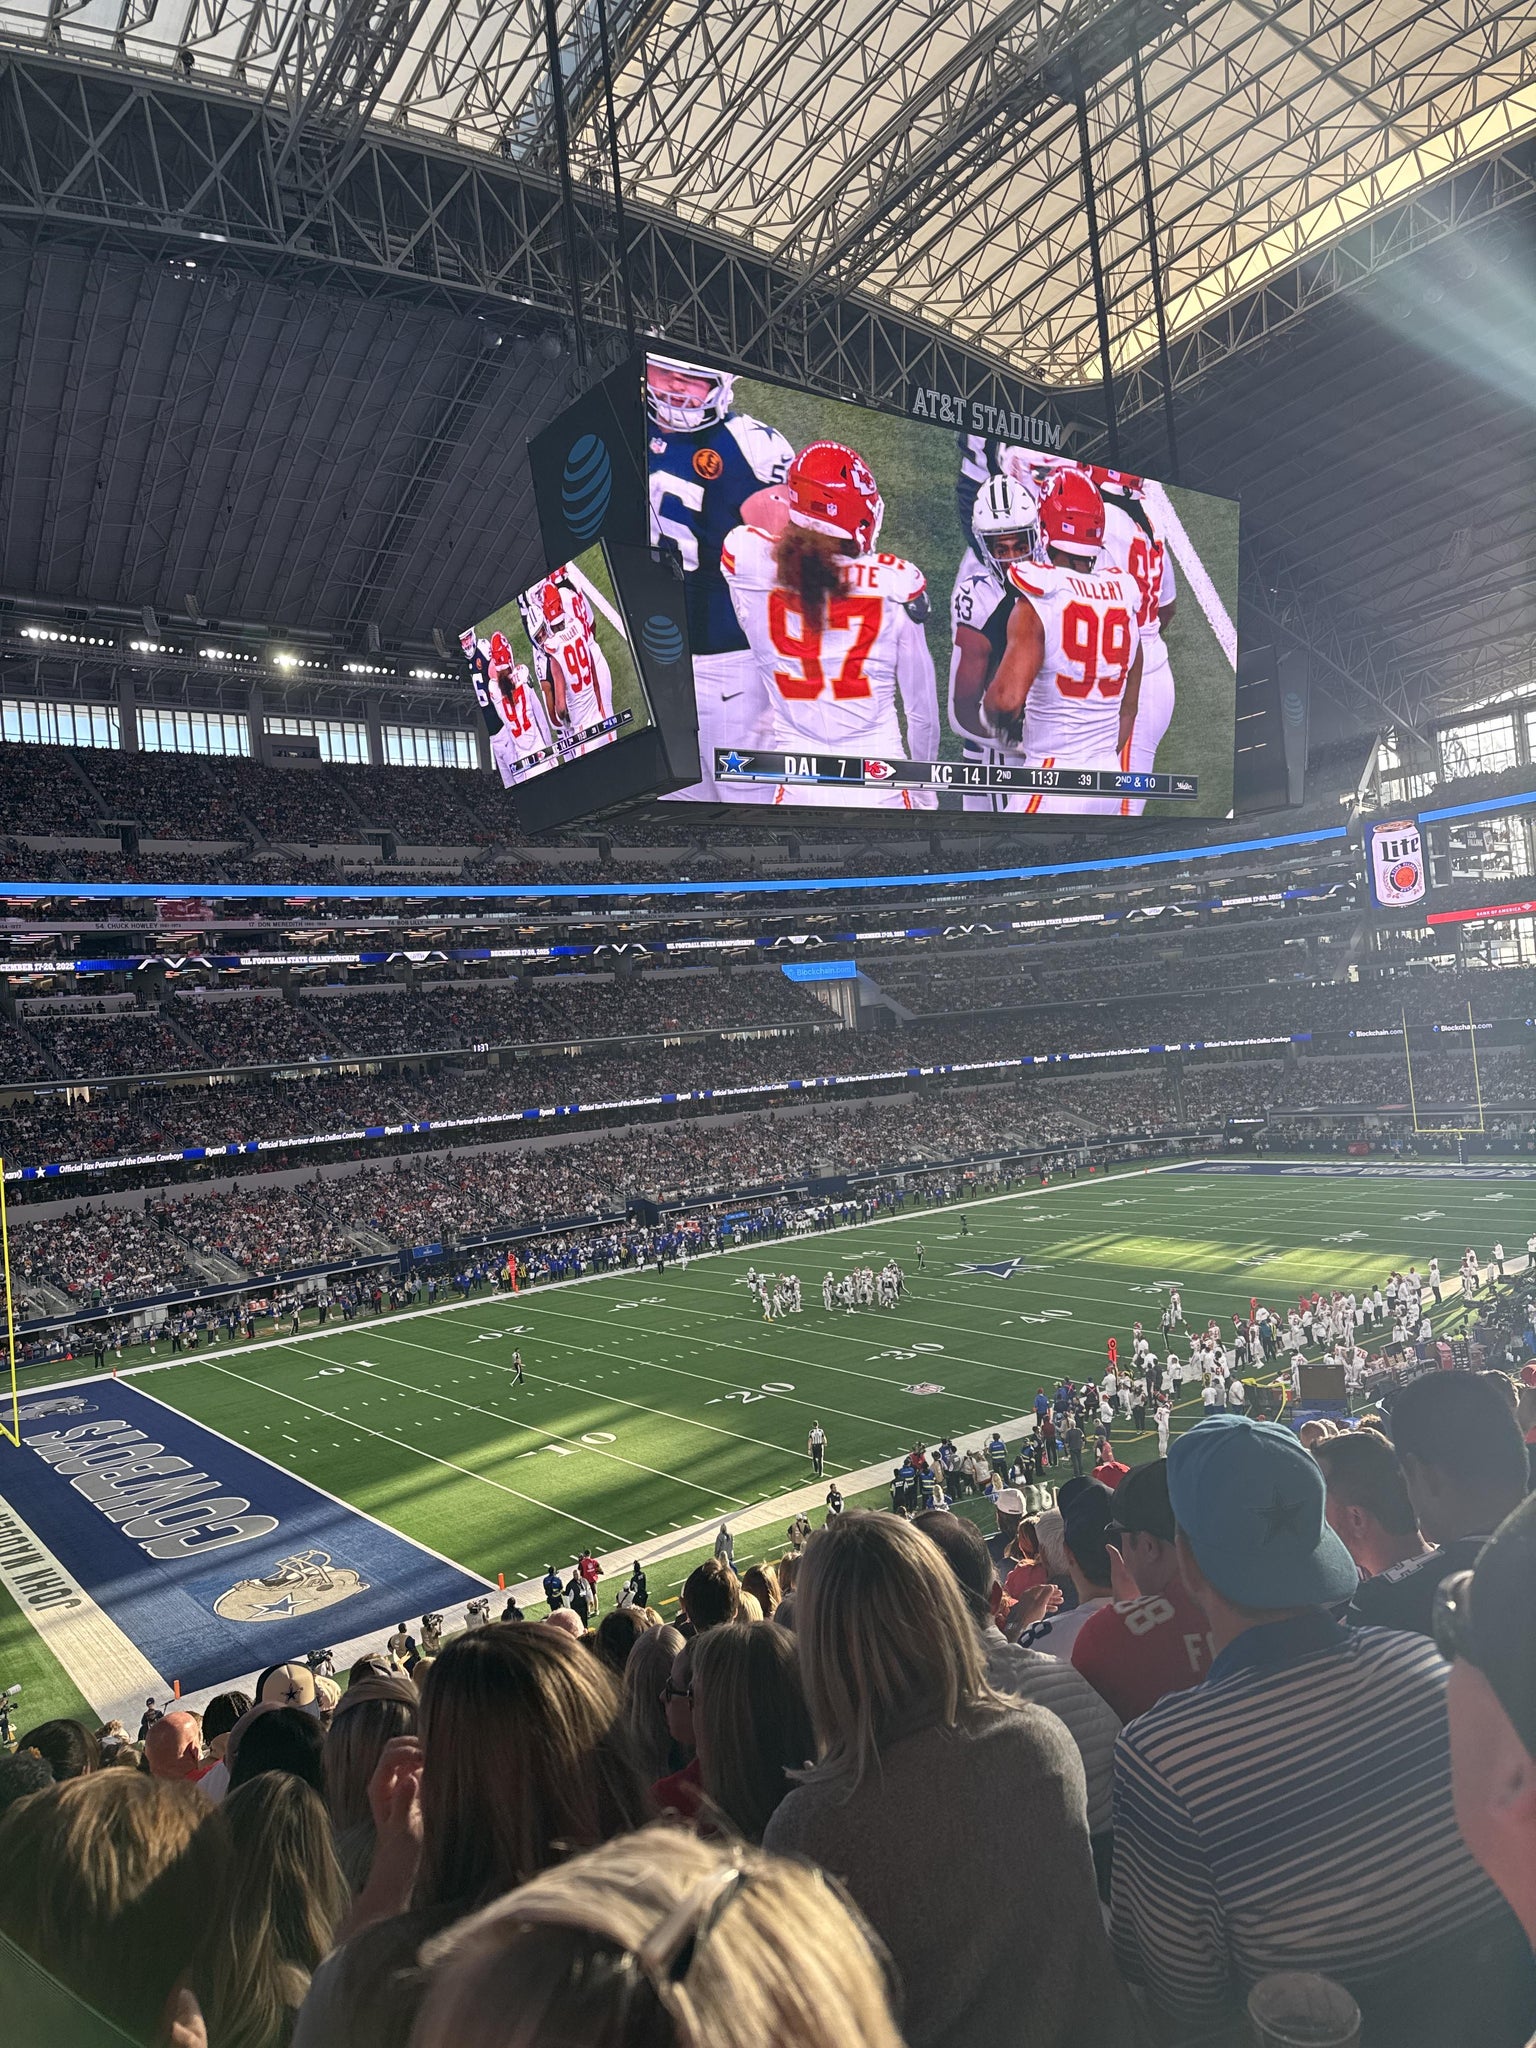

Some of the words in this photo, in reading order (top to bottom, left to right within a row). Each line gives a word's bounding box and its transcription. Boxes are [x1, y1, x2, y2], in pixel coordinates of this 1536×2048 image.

[912, 387, 967, 425] AT&T
[972, 401, 1062, 451] STADIUM
[1066, 576, 1124, 601] TILLERY
[767, 586, 884, 701] 97
[1055, 599, 1132, 700] 99
[563, 637, 592, 695] 99
[502, 683, 532, 739] 97
[784, 756, 820, 777] DAL
[837, 759, 847, 779] 7
[931, 765, 953, 783] KC
[962, 767, 981, 785] 14
[996, 769, 1012, 782] 2ND
[1030, 770, 1060, 786] 11:37
[1077, 774, 1092, 786] :39
[1115, 775, 1132, 787] 2ND
[1134, 777, 1142, 788] &
[1144, 777, 1156, 788] 10
[1380, 836, 1420, 863] Lite
[1498, 906, 1521, 914] AMERICA
[252, 956, 286, 965] FOOTBALL
[308, 954, 360, 964] CHAMPIONSHIPS
[796, 966, 852, 977] Blockchain.com
[1356, 1028, 1404, 1038] Blockchain.com
[1440, 1022, 1493, 1033] Blockchan.com
[473, 1042, 489, 1053] 11:37
[258, 1140, 277, 1150] Official
[288, 1138, 308, 1146] Partner
[325, 1133, 340, 1142] Dallas
[342, 1130, 365, 1140] Cowboys
[59, 1162, 82, 1174] Official
[94, 1160, 118, 1169] Partner
[137, 1155, 154, 1165] Dallas
[156, 1152, 182, 1162] Cowboys
[1128, 1280, 1185, 1294] 50
[1020, 1308, 1074, 1325] 40
[879, 1342, 945, 1361] 30
[724, 1381, 797, 1405] 20
[539, 1431, 617, 1459] 10
[21, 1418, 281, 1560] COWBOYS
[11, 1566, 82, 1612] JOHN
